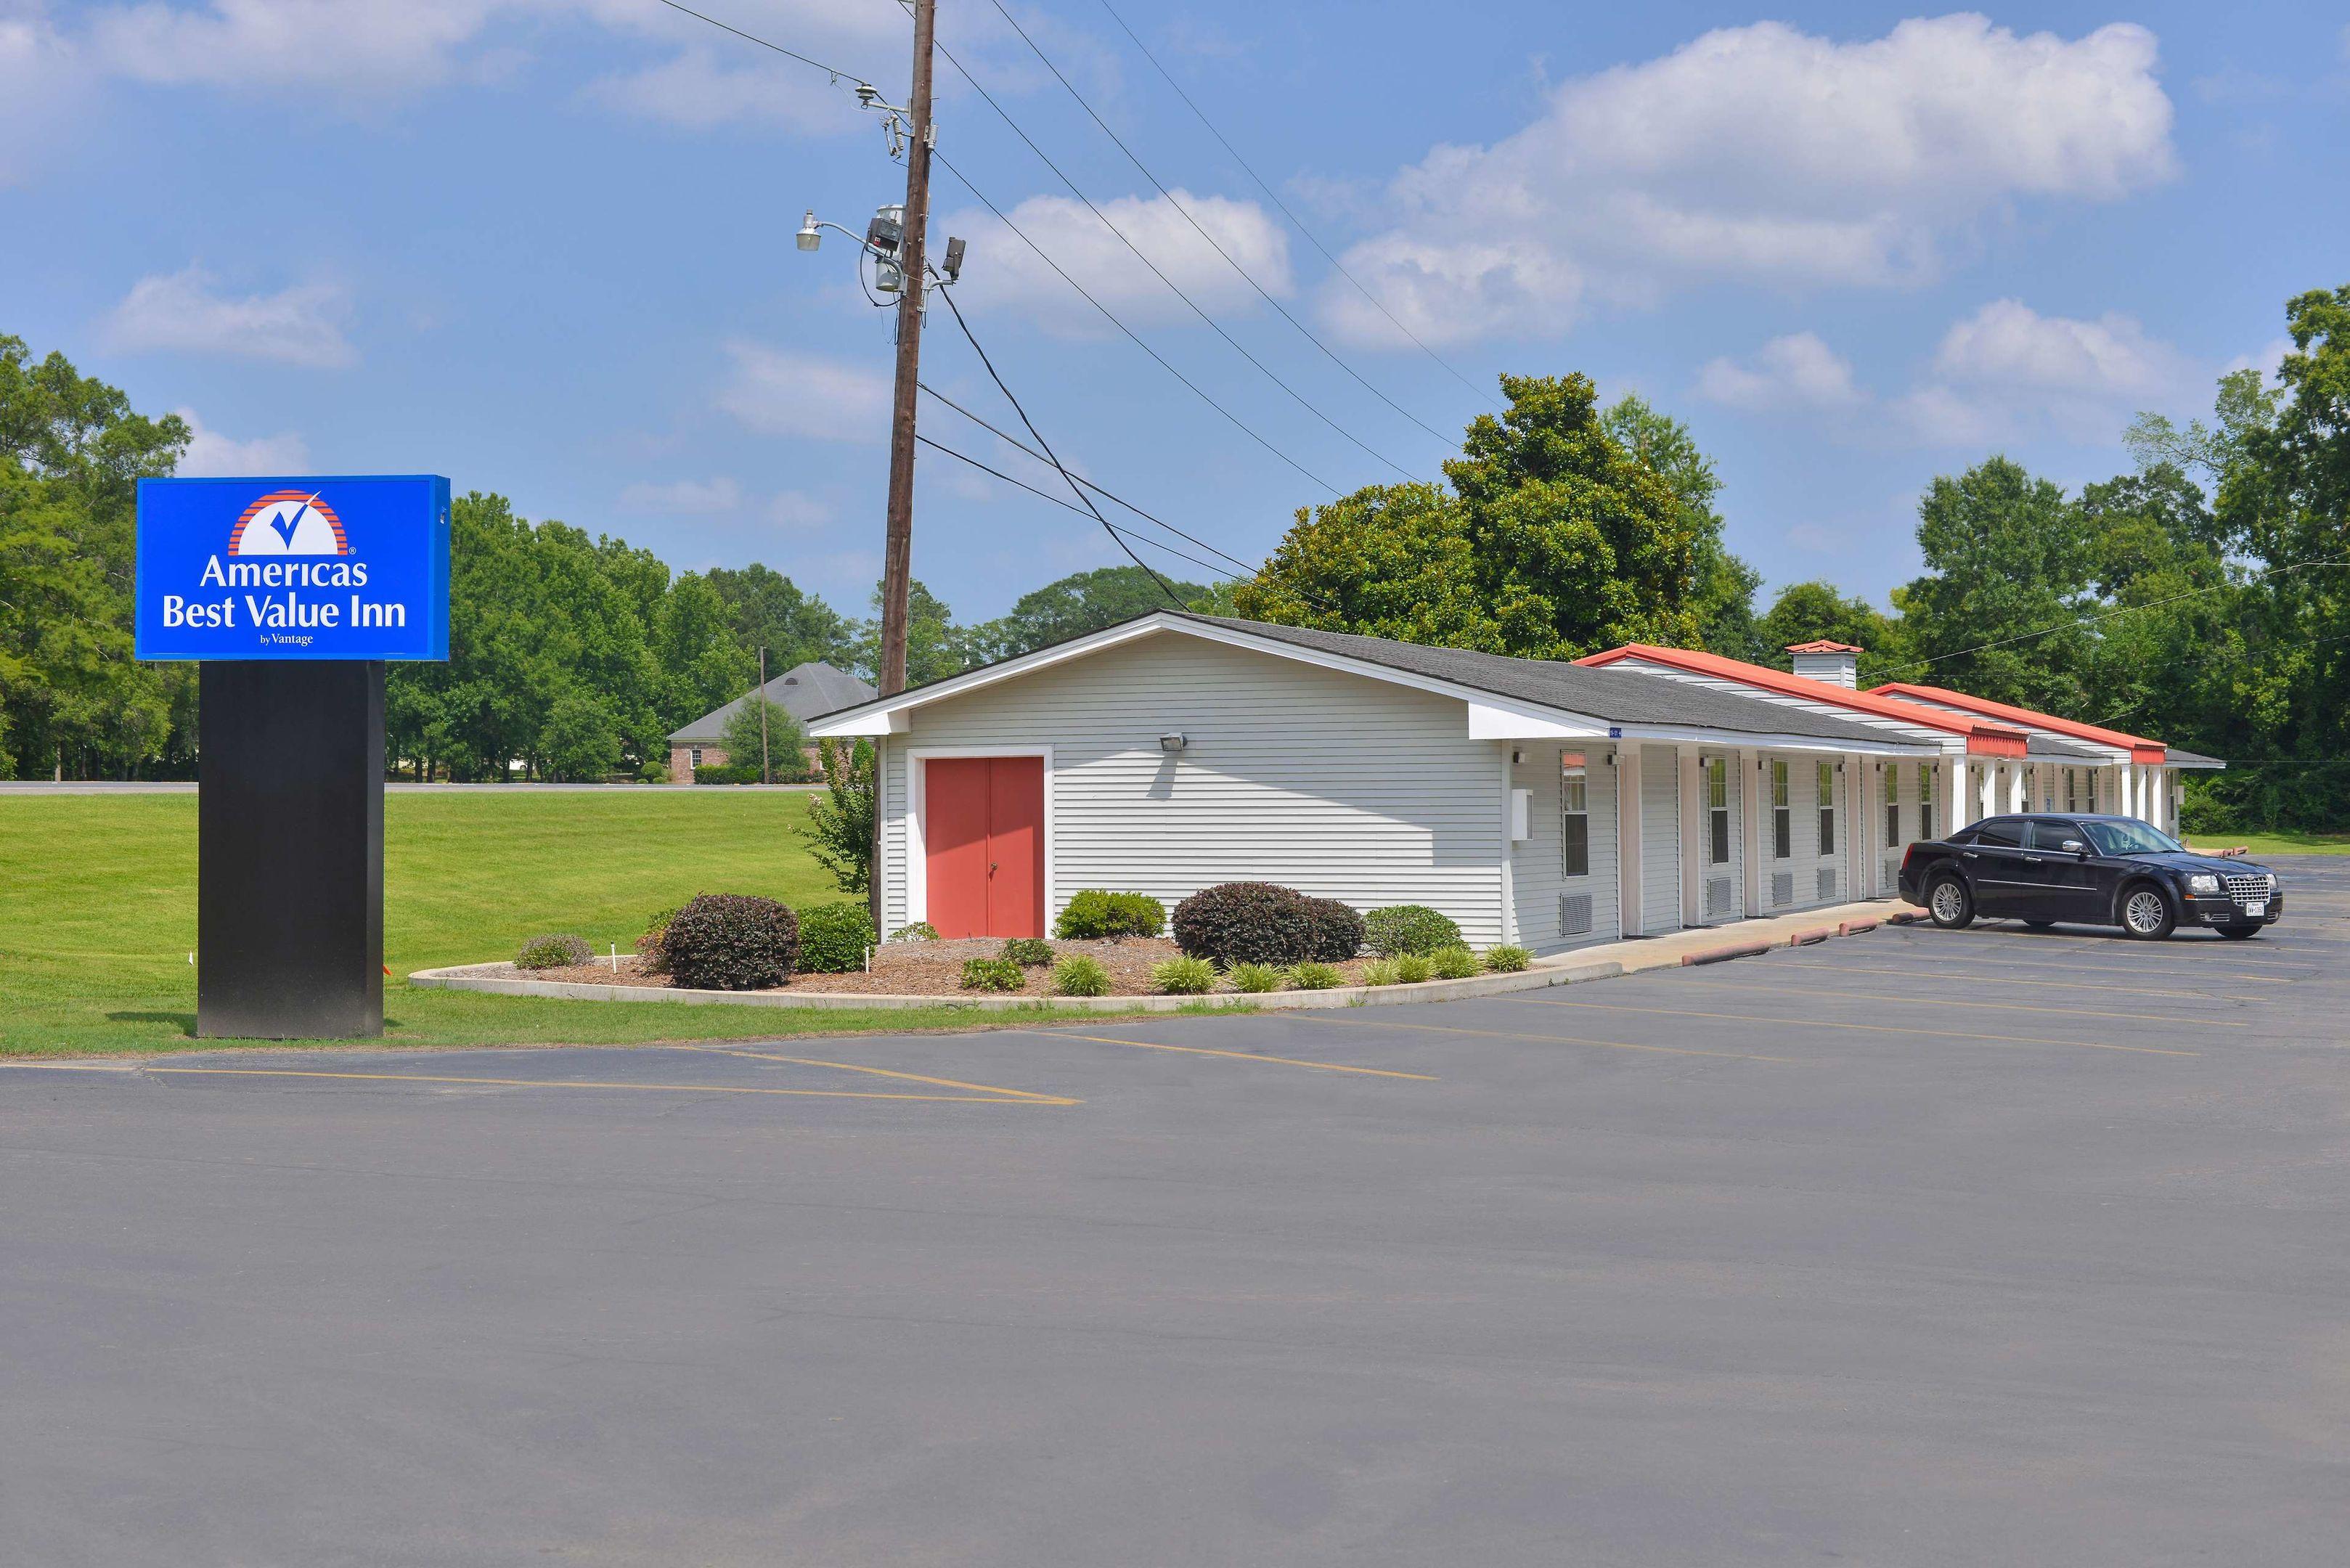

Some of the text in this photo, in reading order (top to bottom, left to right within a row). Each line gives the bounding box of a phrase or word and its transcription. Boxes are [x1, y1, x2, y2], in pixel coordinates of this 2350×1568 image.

[200, 554, 367, 587] Americas
[163, 592, 405, 628] Best Value Inn
[260, 633, 314, 647] by Vantage
